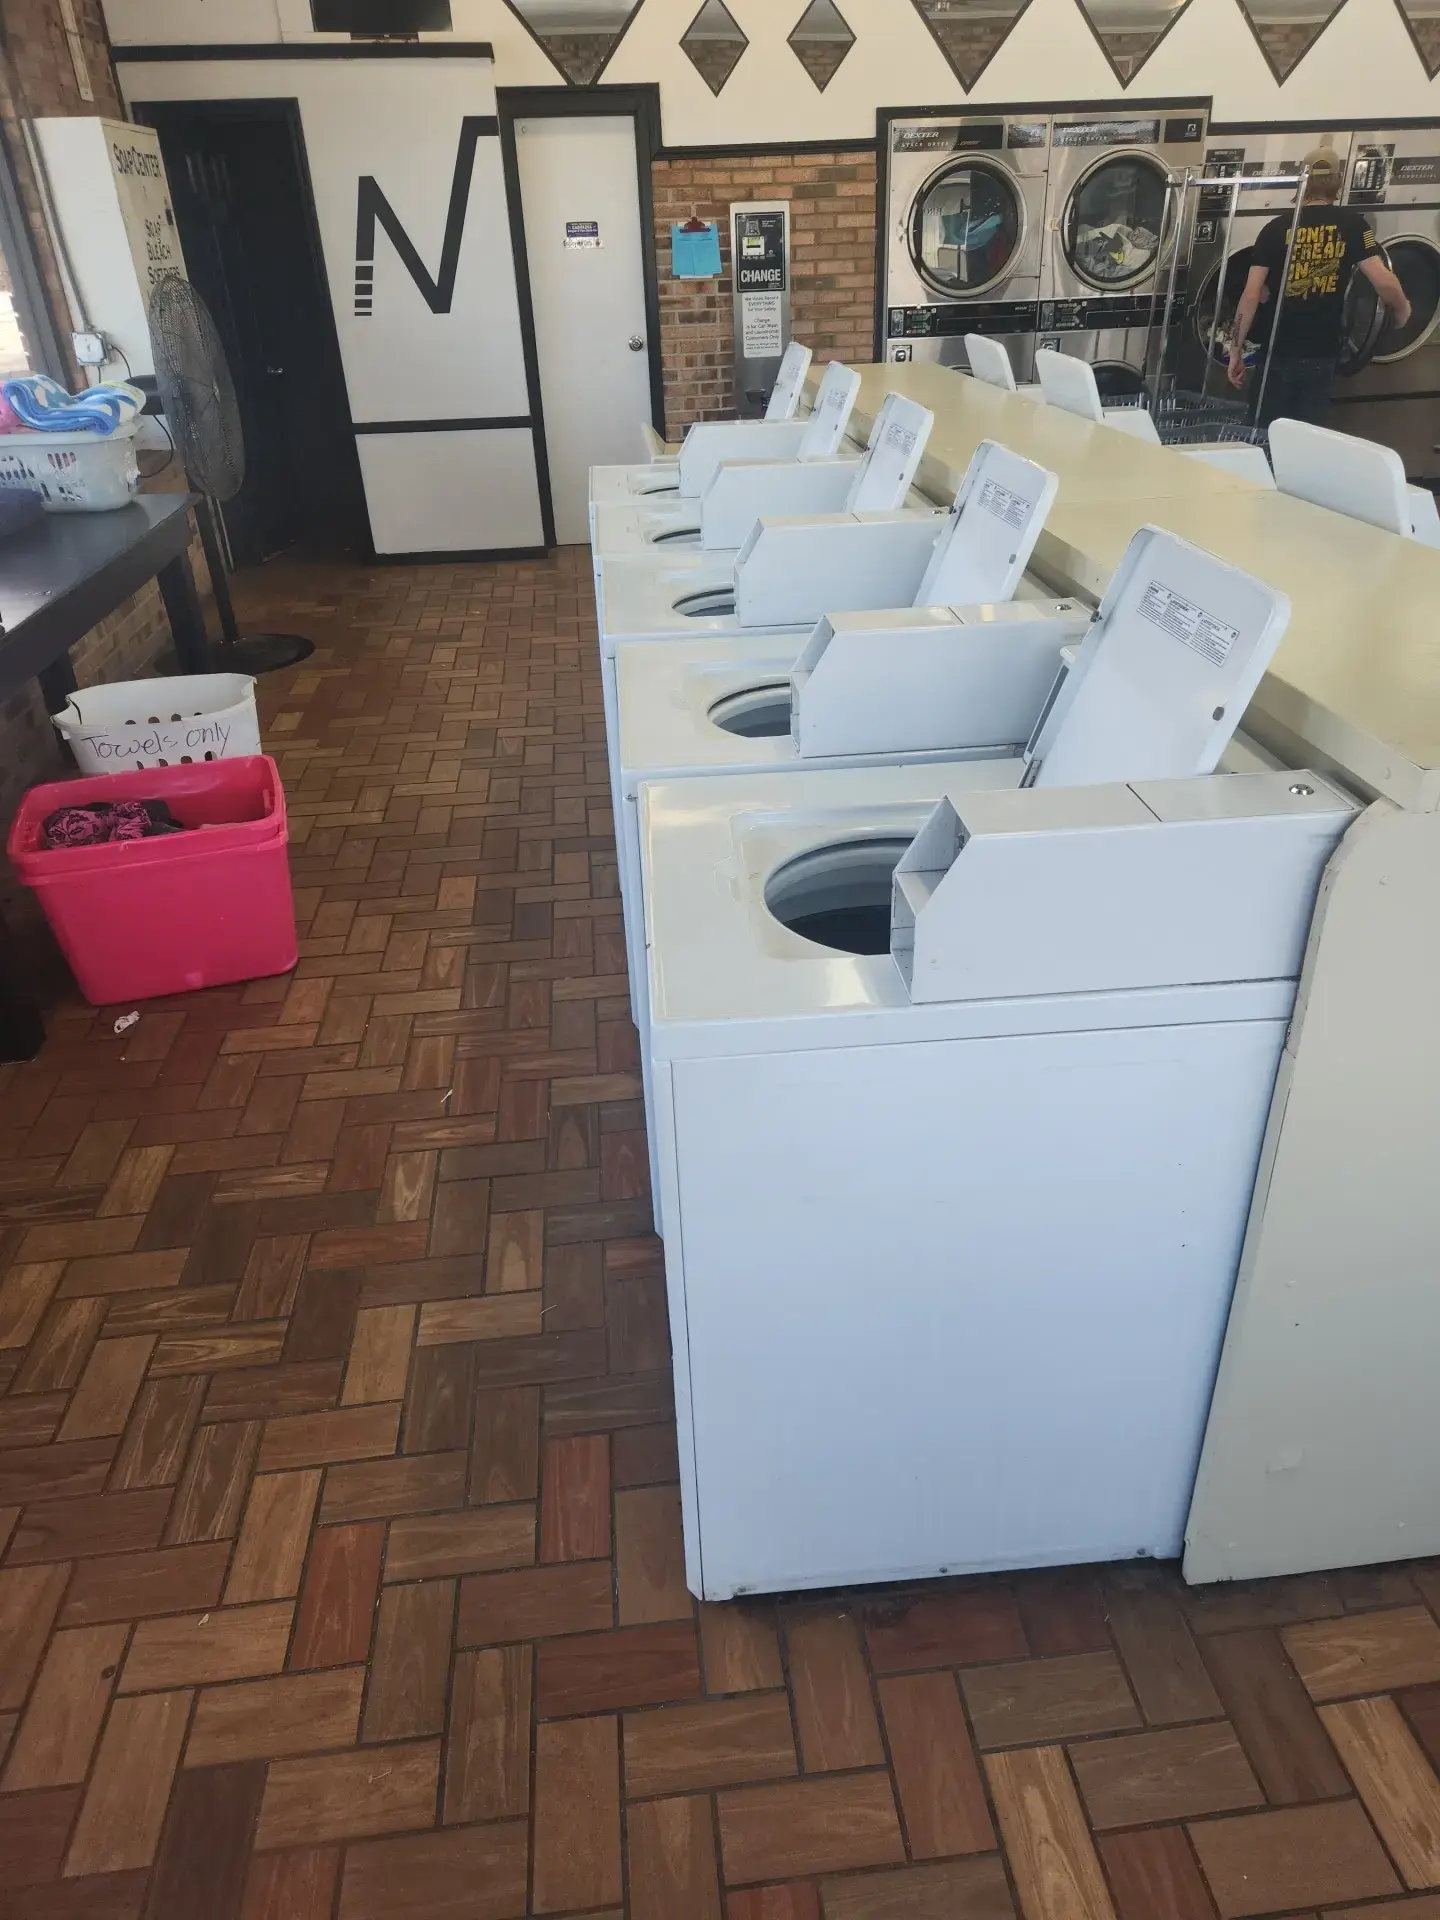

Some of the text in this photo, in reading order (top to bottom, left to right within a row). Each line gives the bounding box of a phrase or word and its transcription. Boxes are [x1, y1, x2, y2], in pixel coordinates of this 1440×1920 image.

[902, 131, 940, 139] DEXTER
[1400, 164, 1434, 172] DEXTER
[146, 241, 173, 261] BLEACH
[740, 268, 782, 283] CHANGE
[1311, 276, 1340, 293] ME
[81, 730, 179, 759] Towels
